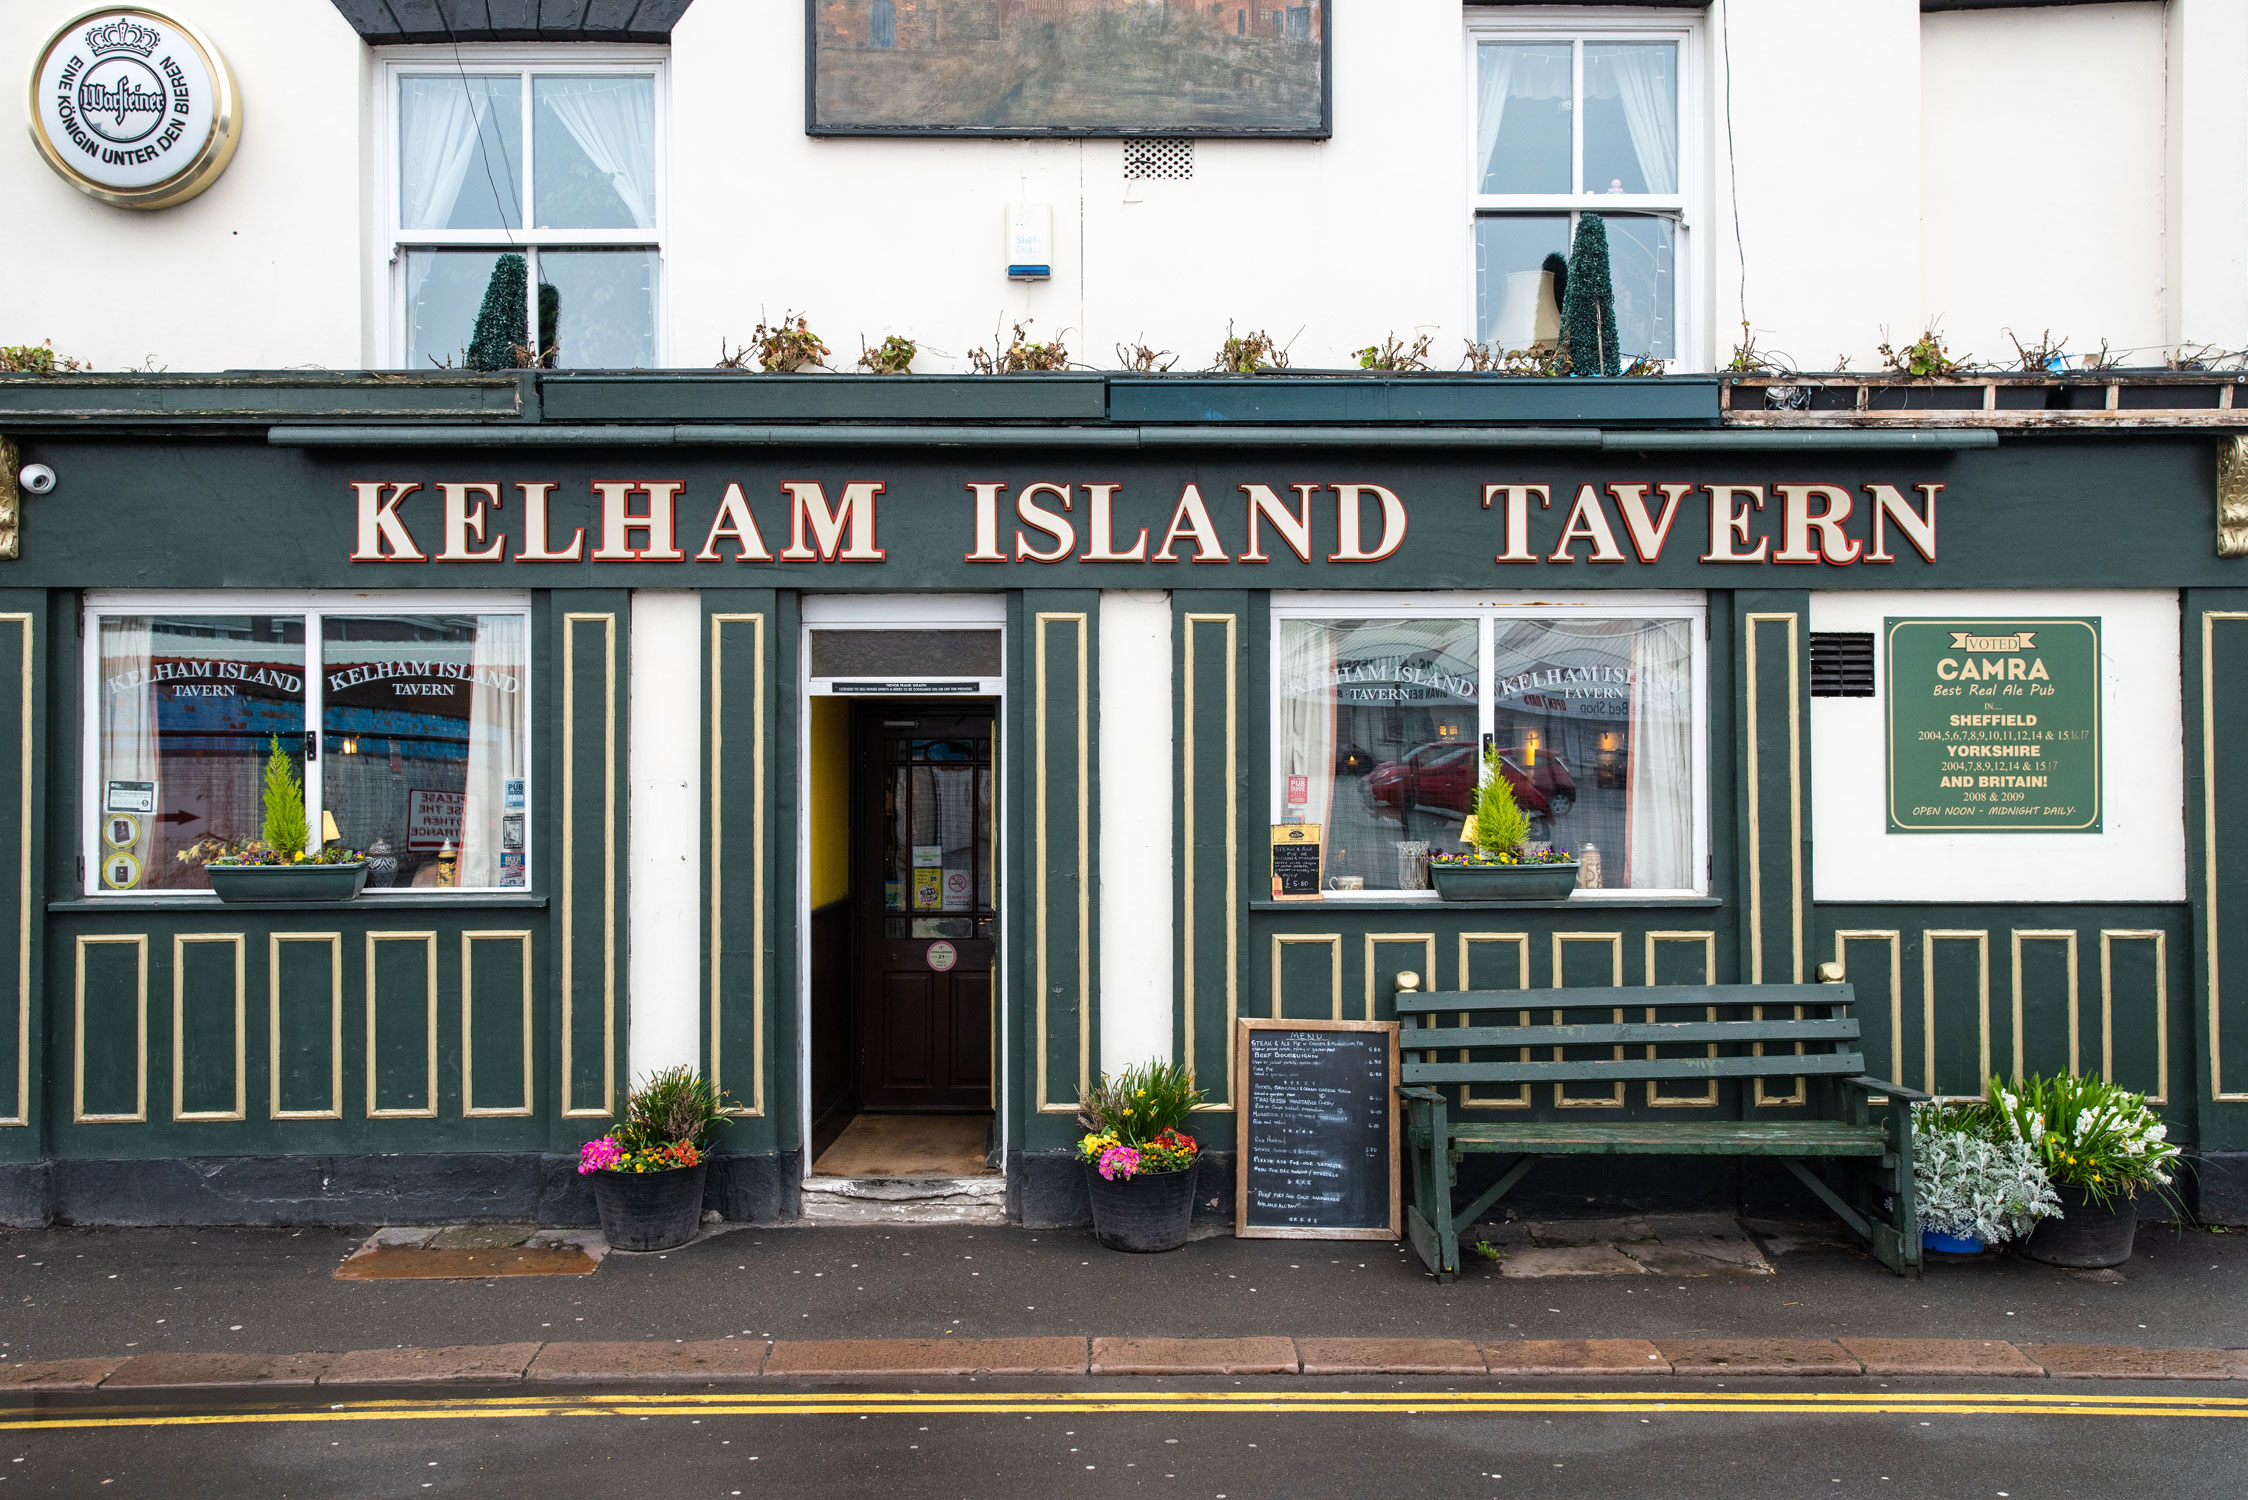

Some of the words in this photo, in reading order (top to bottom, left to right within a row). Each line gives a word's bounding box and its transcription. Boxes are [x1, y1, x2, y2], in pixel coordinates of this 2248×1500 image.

[58, 55, 84, 91] EINE
[160, 56, 189, 115] BIEREN
[57, 95, 100, 158] KÖNIGIN
[156, 118, 186, 153] DEN
[101, 144, 160, 166] UNTER
[349, 480, 887, 563] KELHAM
[964, 481, 1408, 563] ISLAND
[1482, 482, 1947, 565] TAVERN
[1968, 638, 2019, 650] VOTED
[1936, 658, 2050, 681] CAMRA
[108, 661, 213, 695] KELHAM
[217, 661, 301, 694] ISLAND
[328, 660, 432, 692] KELHAM
[437, 660, 519, 694] ISLAND
[1394, 666, 1474, 698] ISLAND
[1500, 666, 1599, 696] KELHAM
[173, 685, 236, 697] TAVERN
[392, 684, 455, 696] TAVERN
[1351, 688, 1413, 700] TAVERN
[1563, 688, 1624, 699] TAVERN
[1933, 684, 1962, 696] Best
[1969, 683, 1997, 696] Real
[2002, 684, 2023, 696] Ale
[2030, 683, 2055, 696] Pub
[1949, 714, 2038, 726] SHEFFIELD
[1918, 731, 2043, 742] 2004,5,6,7,8,9,10,11,12,14
[2045, 731, 2054, 741] &
[1946, 745, 2041, 757] YORKSHIRE
[1941, 761, 2020, 772] 2004,7,8,9,12,14
[2022, 762, 2032, 771] &
[1940, 776, 1974, 788] AND
[1978, 776, 2048, 788] BRITAIN!
[1963, 792, 1986, 802] 2008
[1989, 792, 1999, 802] &
[2001, 792, 2025, 802] 2009
[1912, 806, 1940, 816] OPEN
[1945, 806, 1975, 815] NOON
[1988, 806, 2040, 816] MIDNIGHT
